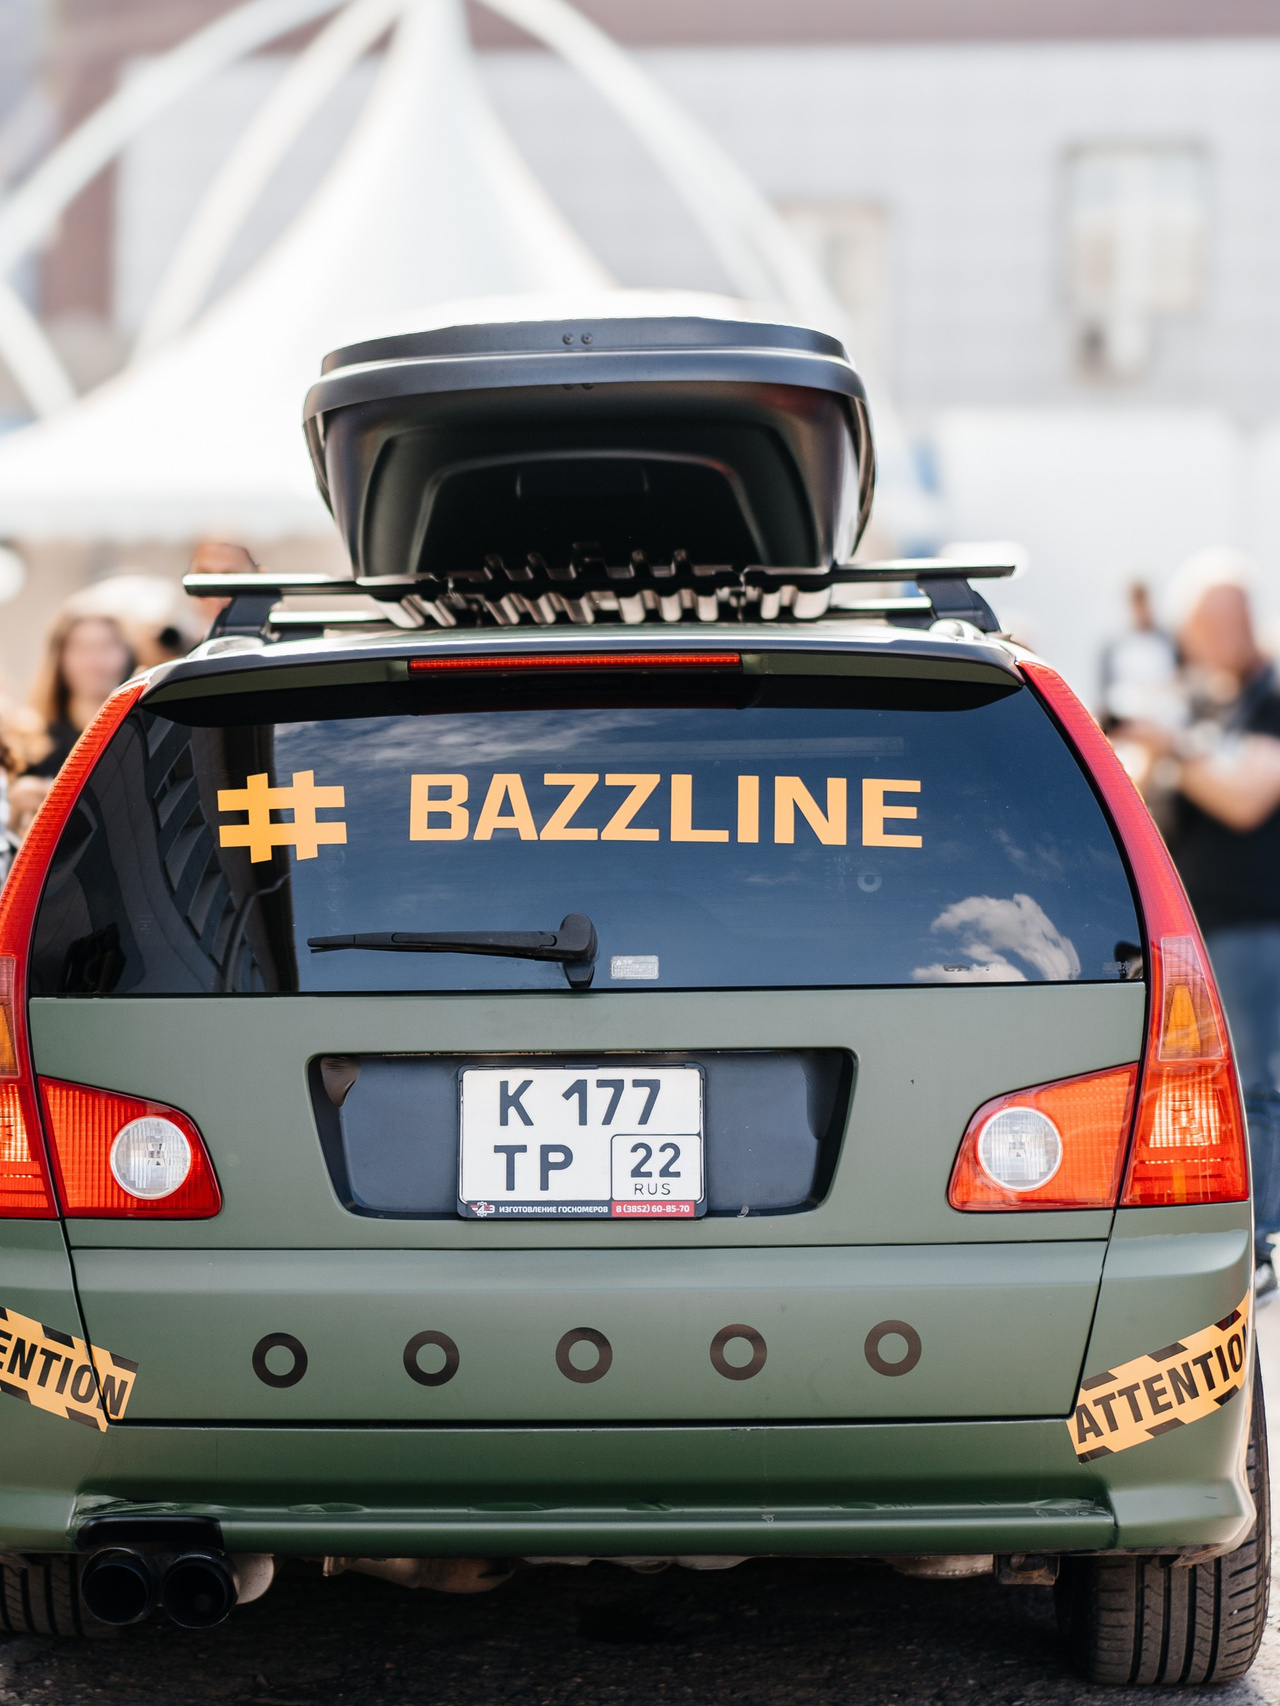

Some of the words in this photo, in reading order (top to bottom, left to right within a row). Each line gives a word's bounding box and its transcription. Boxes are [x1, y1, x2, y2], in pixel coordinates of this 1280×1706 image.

[409, 772, 923, 849] BAZZLINE
[561, 1079, 661, 1126] 177
[630, 1142, 681, 1178] 22
[634, 1183, 671, 1196] RUS
[498, 1205, 557, 1213] ИЗГОТОВЛЕНИЕ
[557, 1205, 609, 1213] ГОСНОМЕРОВ
[651, 1204, 690, 1213] 60-85-70
